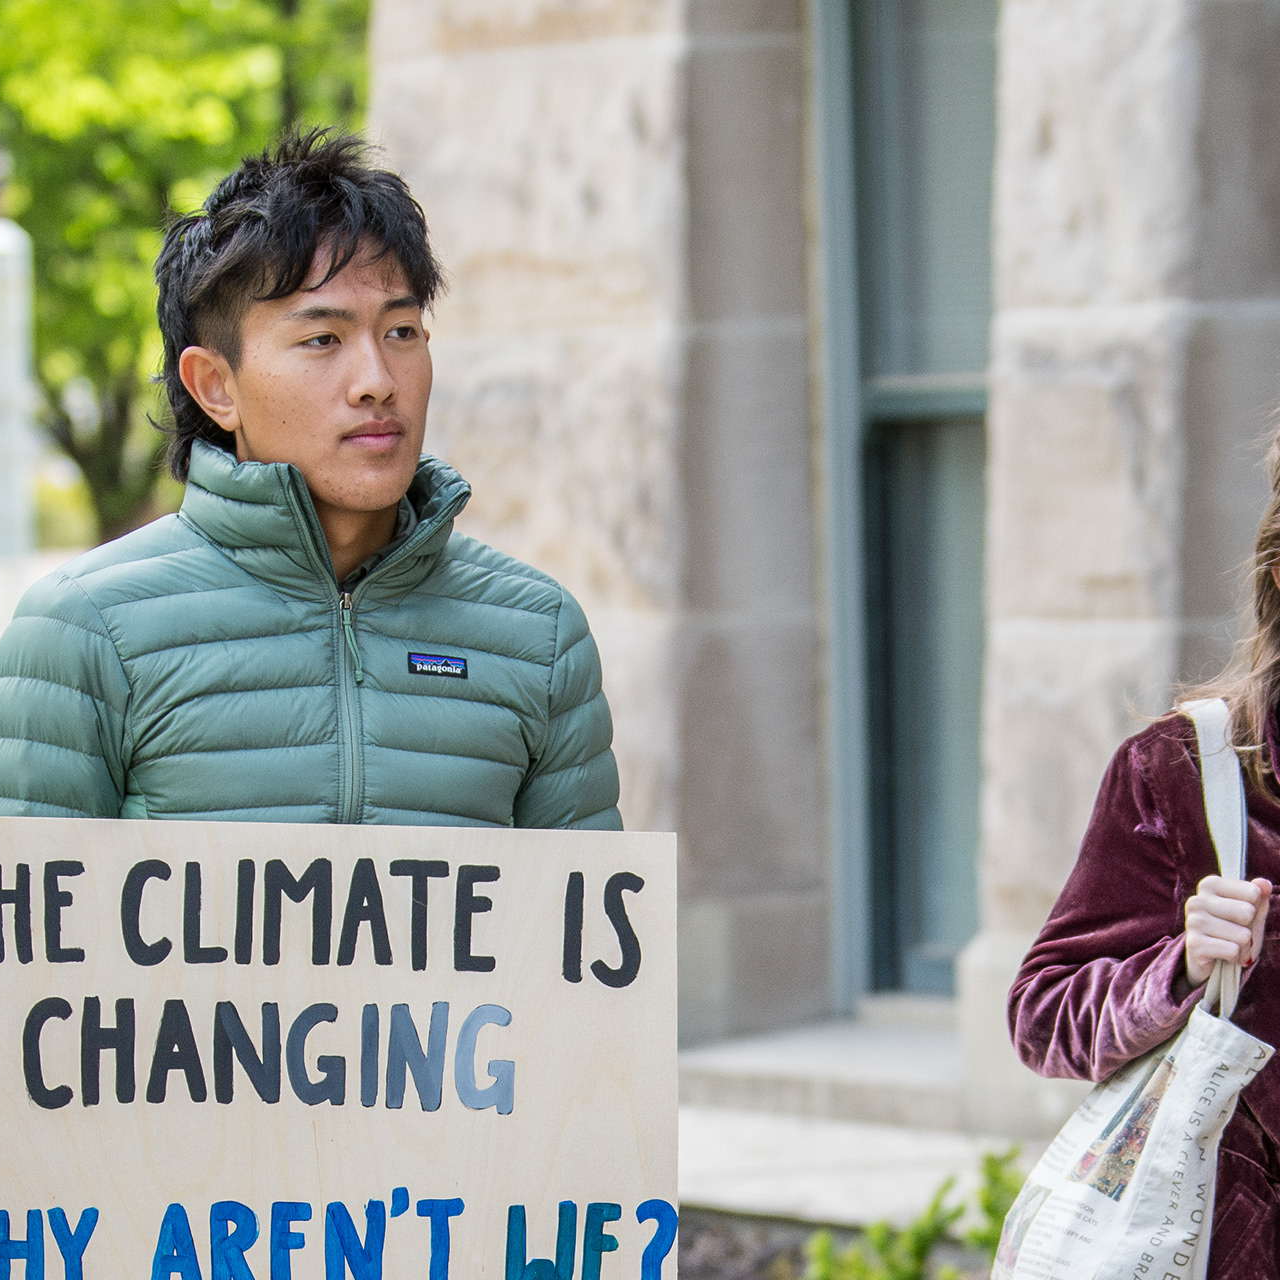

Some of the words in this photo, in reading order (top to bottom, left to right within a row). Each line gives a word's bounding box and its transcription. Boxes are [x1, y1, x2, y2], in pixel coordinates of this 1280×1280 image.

[416, 663, 462, 674] patagonia
[121, 858, 502, 973] CLIMATE
[562, 871, 646, 988] IS
[23, 996, 517, 1115] CHANGING
[1198, 1061, 1230, 1106] ALICE
[1183, 1131, 1193, 1141] A
[1188, 1110, 1205, 1127] IS
[1168, 1150, 1189, 1211] CLEVER
[1149, 1215, 1175, 1247] AND
